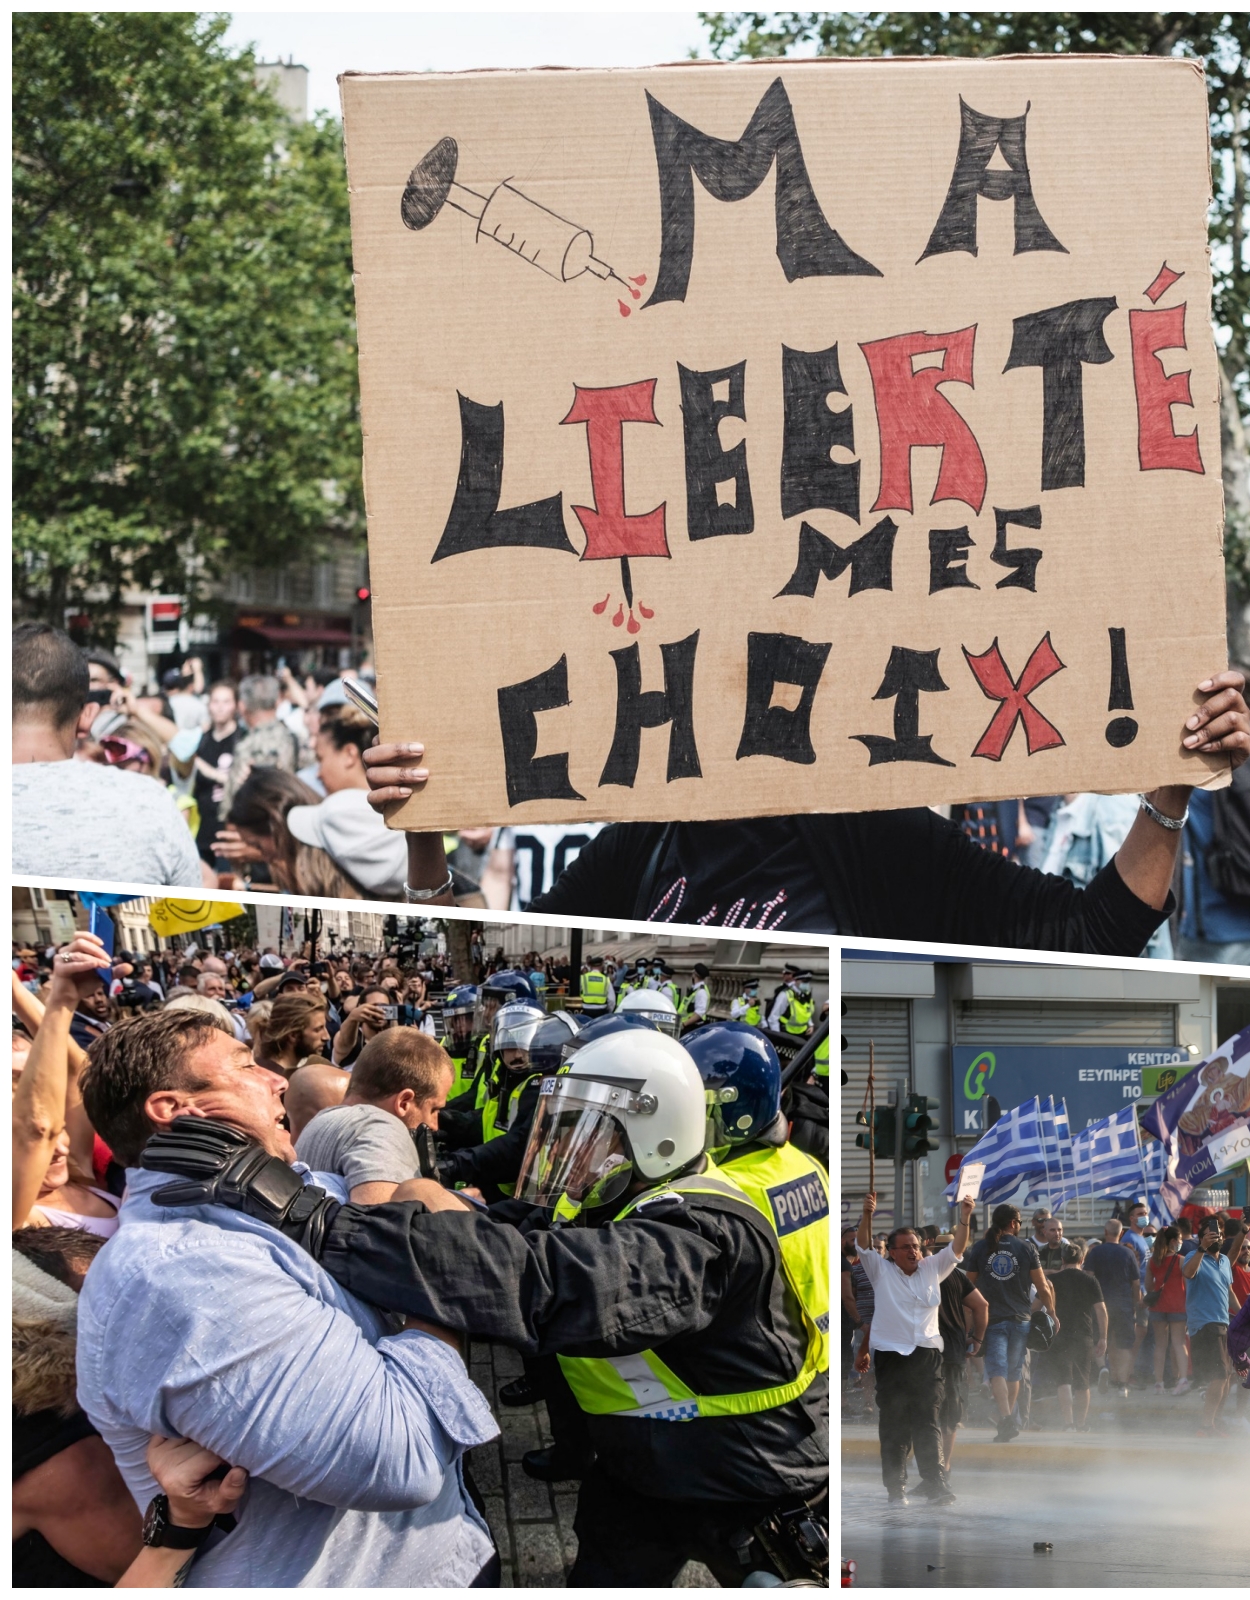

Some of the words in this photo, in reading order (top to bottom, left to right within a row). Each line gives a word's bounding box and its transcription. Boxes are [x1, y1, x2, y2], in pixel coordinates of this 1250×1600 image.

[640, 76, 1070, 310] MA
[431, 260, 1205, 563] LIBERTÉ
[772, 504, 1043, 599] MES
[652, 1013, 672, 1021] POLICE
[1128, 1053, 1181, 1065] ΚΕΝΤΡΟ
[1157, 1072, 1175, 1092] Life
[773, 1180, 827, 1227] POLICE
